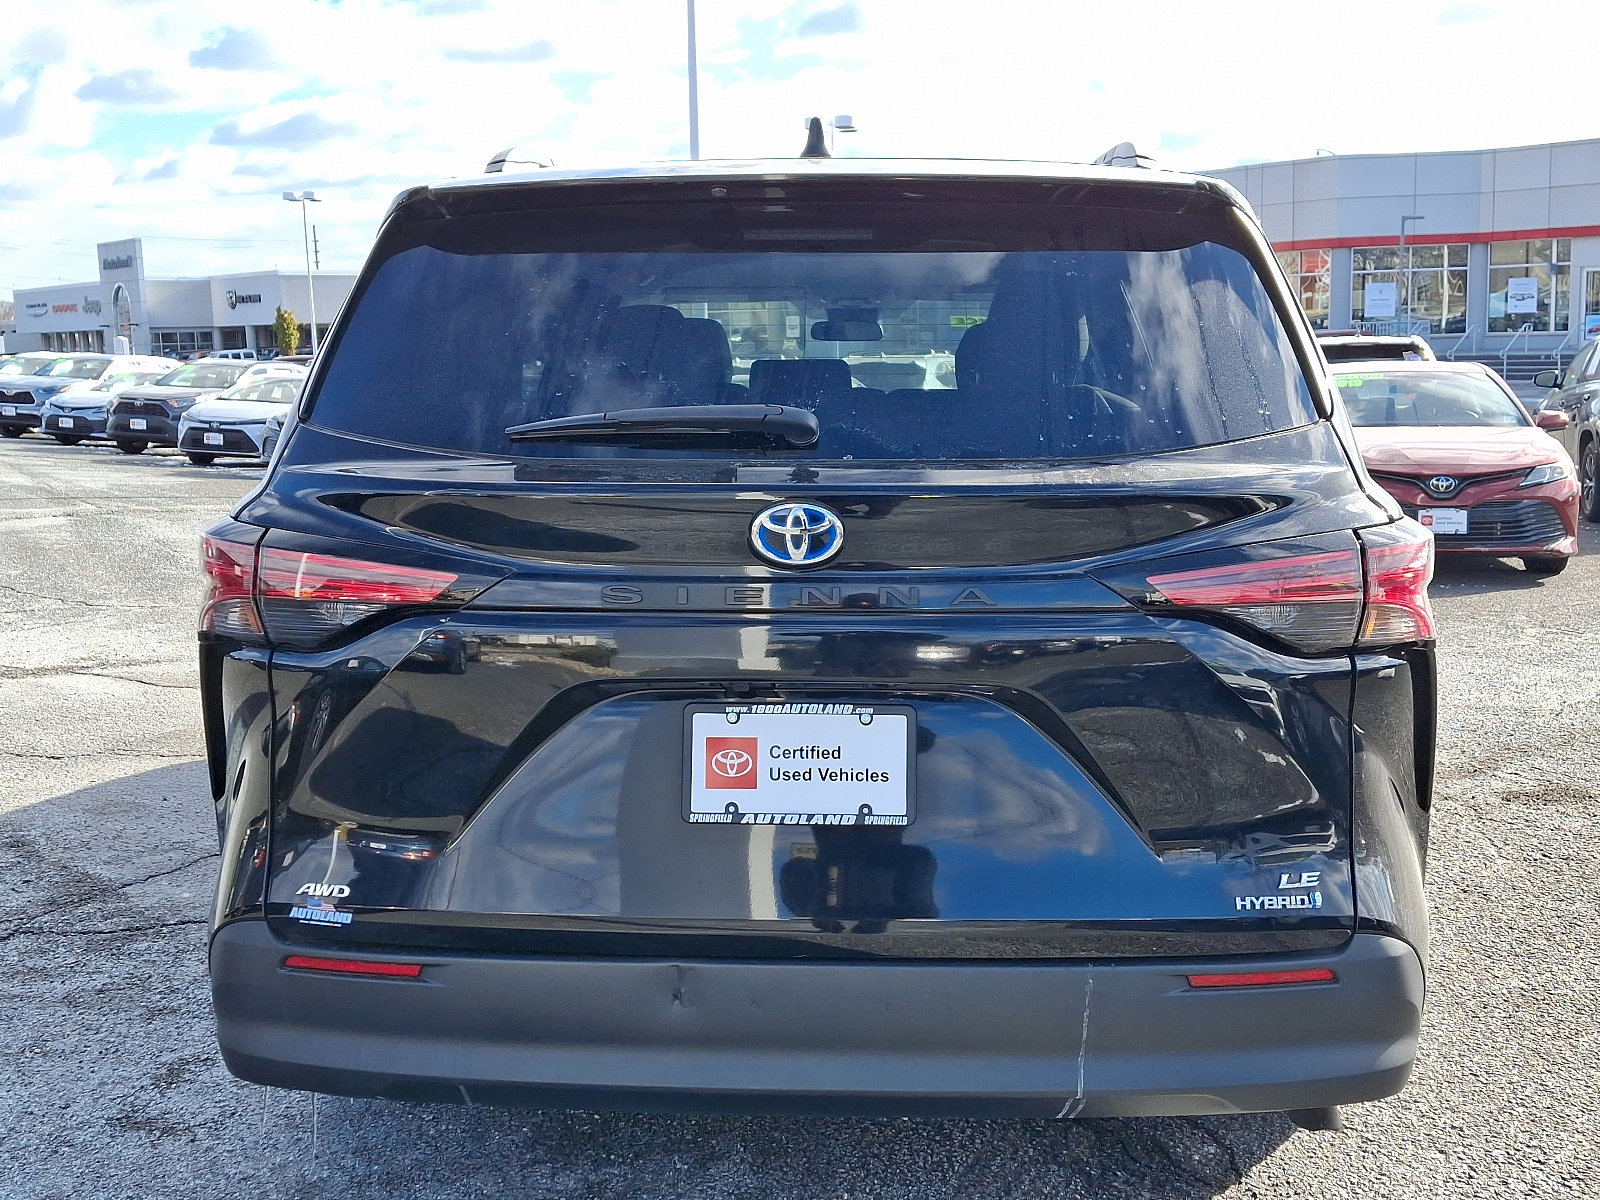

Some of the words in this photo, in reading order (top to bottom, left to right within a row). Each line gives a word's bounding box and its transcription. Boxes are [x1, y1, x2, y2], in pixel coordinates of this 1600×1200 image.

[600, 585, 997, 606] SIENNA
[769, 744, 842, 760] Certified
[769, 767, 812, 782] Used
[818, 767, 890, 783] Vehicles
[689, 813, 732, 823] SPRINGFIELD
[740, 814, 857, 825] AUTOLAND
[864, 815, 908, 825] SPRINGFIELD
[1278, 871, 1321, 889] LE
[296, 883, 350, 897] AWD
[1235, 895, 1312, 910] HYBRID
[289, 907, 352, 923] AUTOLAND
